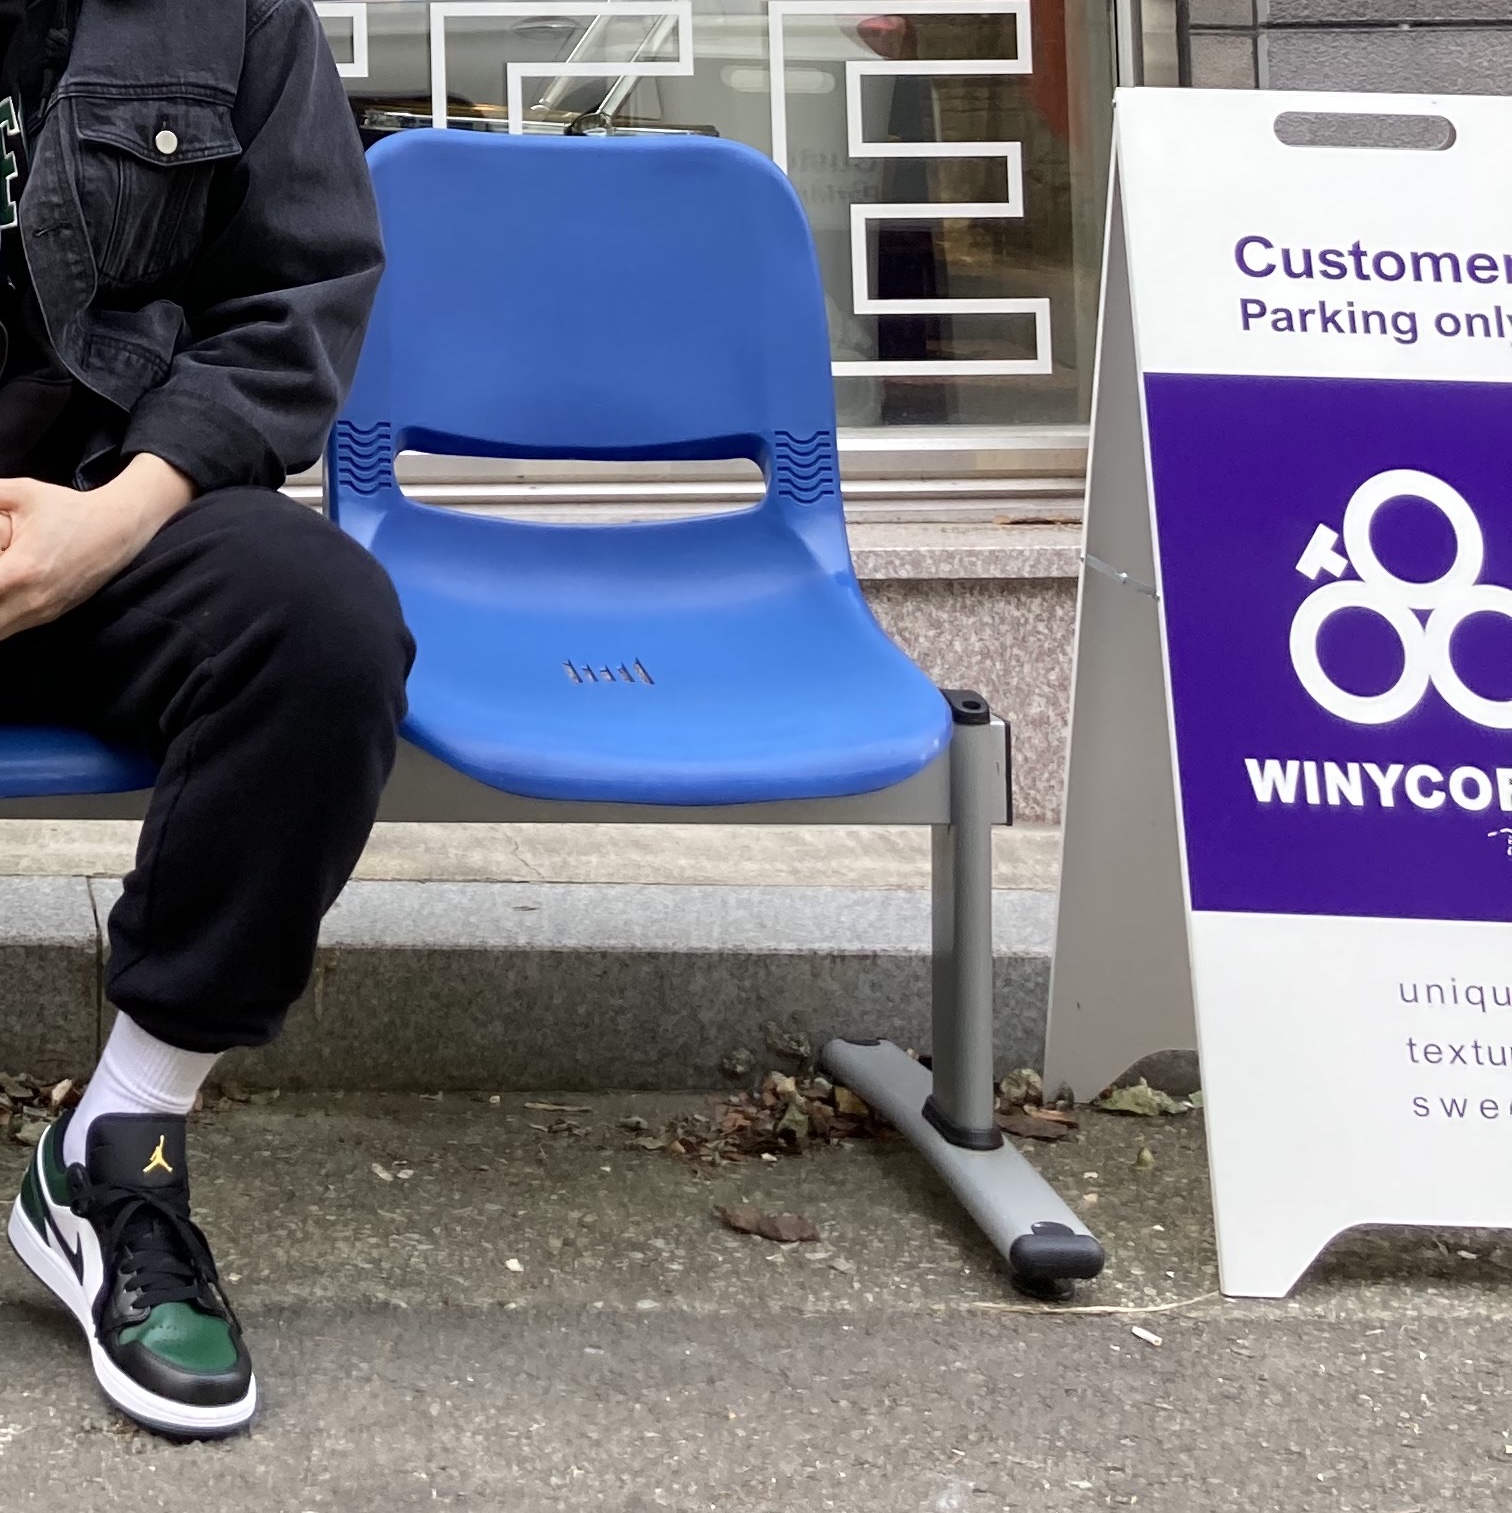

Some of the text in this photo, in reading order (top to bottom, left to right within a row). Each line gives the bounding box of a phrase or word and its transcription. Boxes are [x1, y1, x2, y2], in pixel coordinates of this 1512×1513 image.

[1240, 297, 1512, 347] Parking onl
[1398, 977, 1512, 1013] uniqu
[1406, 1037, 1512, 1066] textu
[1412, 1096, 1512, 1120] swe
